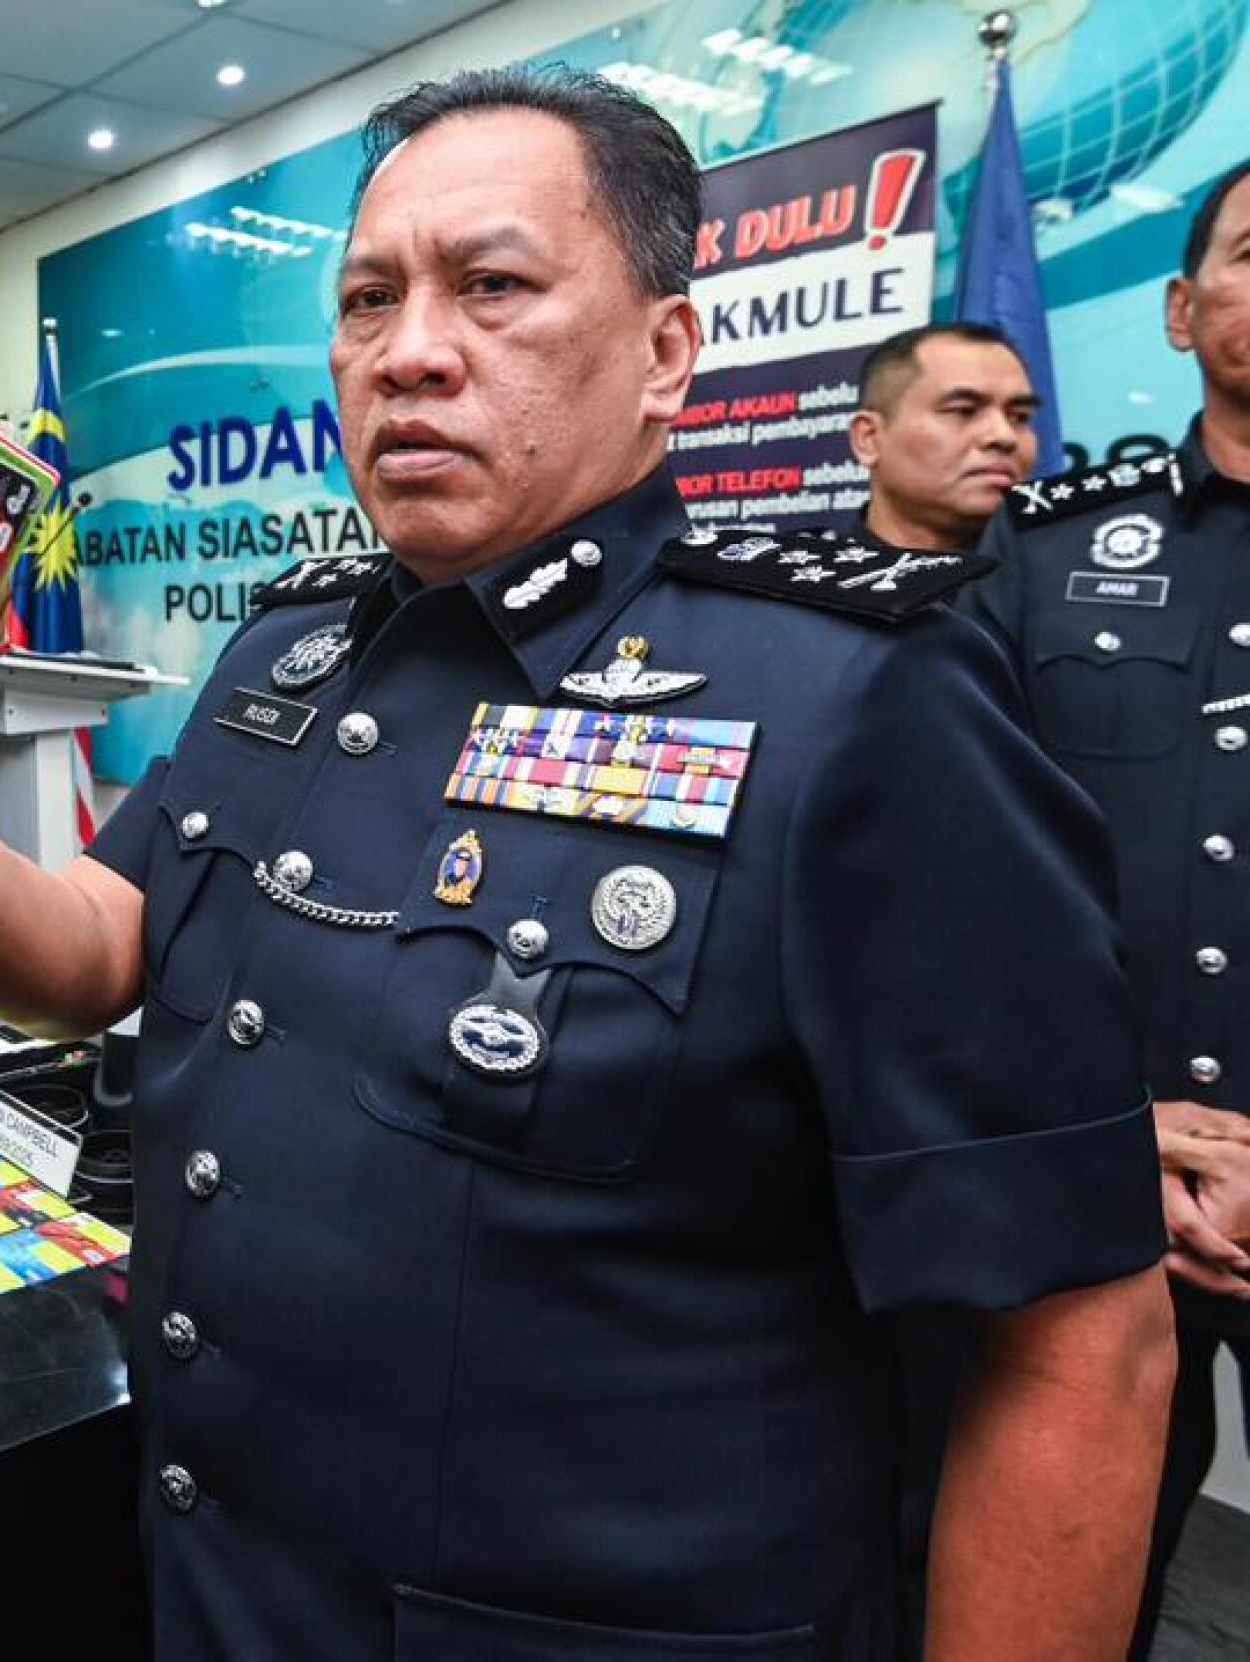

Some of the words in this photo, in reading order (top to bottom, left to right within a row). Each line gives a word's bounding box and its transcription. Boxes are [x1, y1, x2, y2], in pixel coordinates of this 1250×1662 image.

[734, 184, 857, 259] DULU
[712, 268, 904, 344] KMULE
[717, 465, 802, 493] TELEFON
